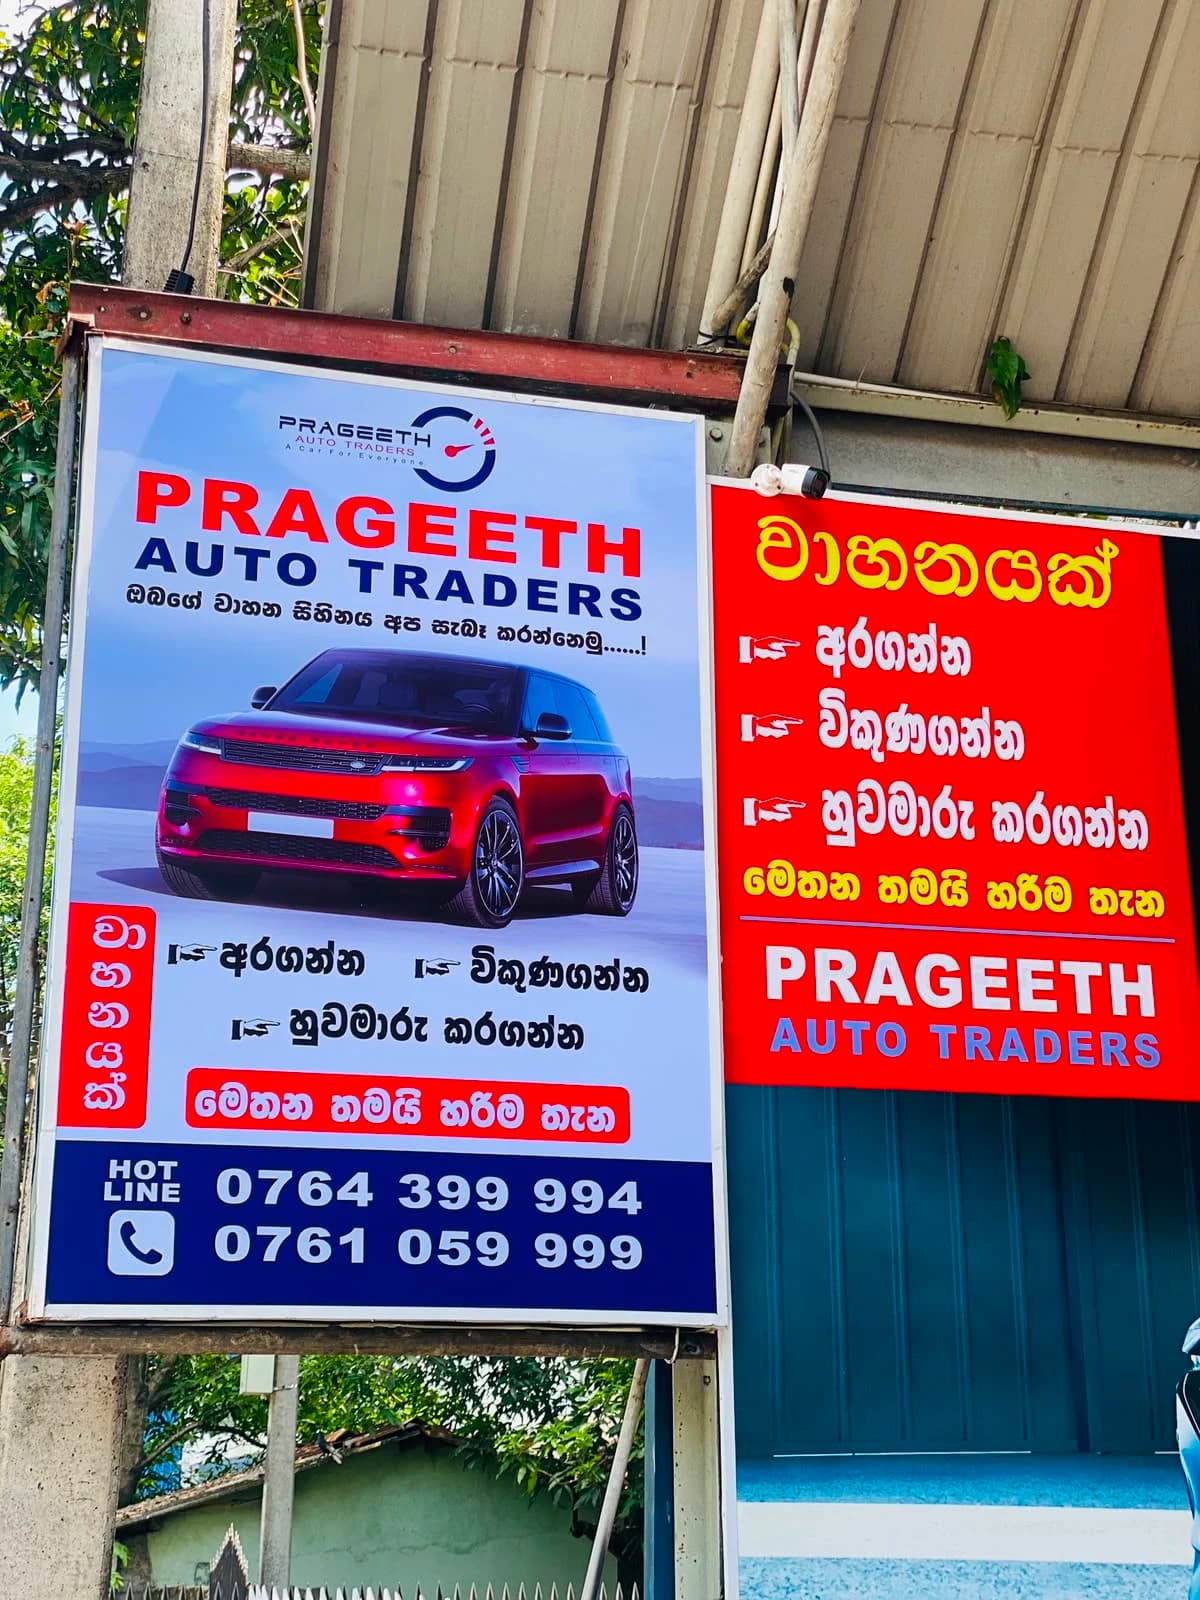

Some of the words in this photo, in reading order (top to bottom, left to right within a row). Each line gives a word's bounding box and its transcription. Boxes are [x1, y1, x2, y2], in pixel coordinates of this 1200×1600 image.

[279, 415, 431, 448] PRAGEETH
[295, 434, 337, 448] AUTO
[343, 440, 416, 457] TRADERS
[329, 449, 351, 457] For
[359, 452, 424, 466] Everyone
[135, 469, 643, 579] PRAGEETH
[134, 536, 318, 588] AUTO
[347, 558, 643, 623] TRADERS
[756, 514, 1119, 609] වාහනයක්
[126, 583, 202, 610] ඔබගේ
[213, 592, 282, 619] වාහන
[292, 600, 373, 628] සිහිනය
[383, 613, 421, 635] අප
[431, 618, 488, 639] සැබෑ
[814, 616, 972, 678] අරගන්න
[818, 687, 1026, 763] විකුණගන්න
[821, 778, 975, 848] හුවමාරු
[990, 790, 1149, 851] කරගන්න
[743, 858, 862, 902] මෙතන
[877, 868, 970, 907] තමයි
[986, 874, 1073, 913] හරිම
[1088, 885, 1167, 918] තැන
[219, 936, 366, 978] අරගන්න
[470, 944, 650, 994] විකුණගන්න
[764, 945, 1158, 1018] PRAGEETH
[289, 1002, 429, 1047] හුවමාරු
[443, 1011, 585, 1051] කරගන්න
[769, 1016, 907, 1058] AUTO
[929, 1023, 1162, 1069] TRADERS
[194, 1082, 314, 1122] මෙතන
[330, 1087, 422, 1126] තමයි
[438, 1091, 526, 1131] හරිම
[540, 1102, 617, 1133] තැන
[103, 1181, 181, 1203] LINE
[108, 1158, 179, 1181] HOT
[216, 1167, 374, 1208] 0764
[398, 1175, 510, 1212] 399
[533, 1179, 643, 1217] 994
[214, 1225, 365, 1265] 0761
[398, 1229, 510, 1268] 059
[534, 1233, 643, 1270] 999
